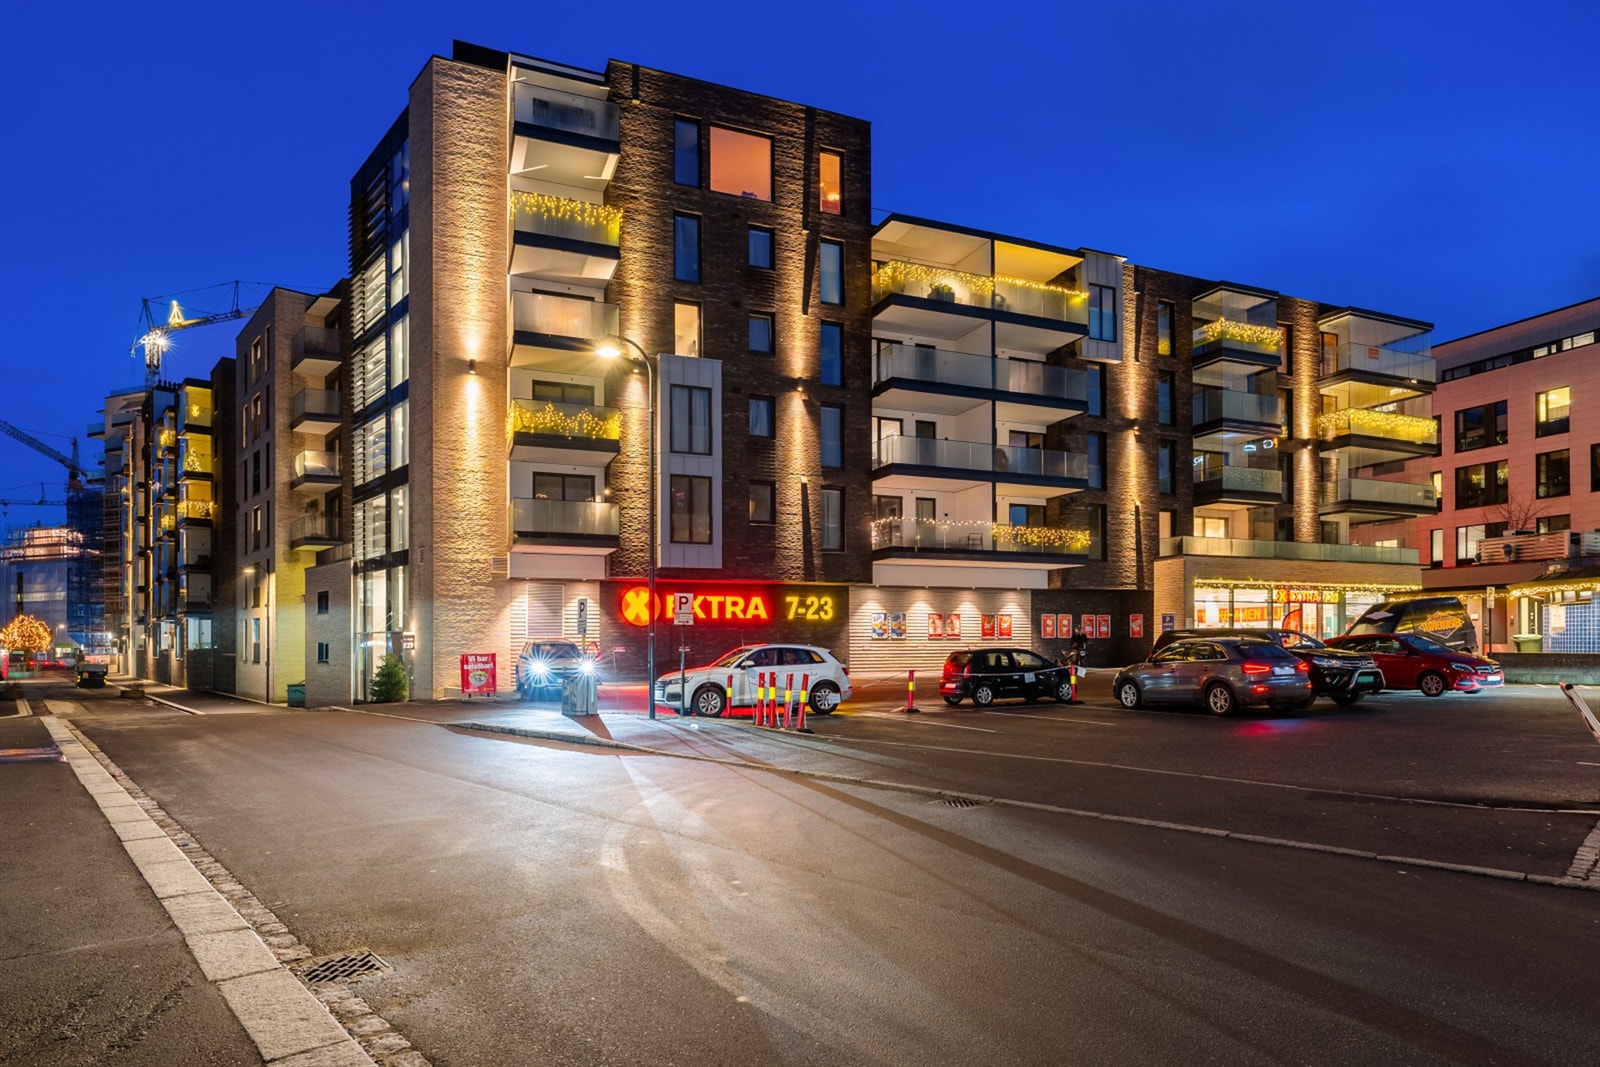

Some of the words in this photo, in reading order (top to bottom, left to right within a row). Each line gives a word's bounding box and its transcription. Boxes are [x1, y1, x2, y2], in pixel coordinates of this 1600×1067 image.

[678, 596, 689, 610] P
[1290, 591, 1319, 602] EXTRA
[579, 602, 585, 618] P
[786, 596, 833, 619] 7-23
